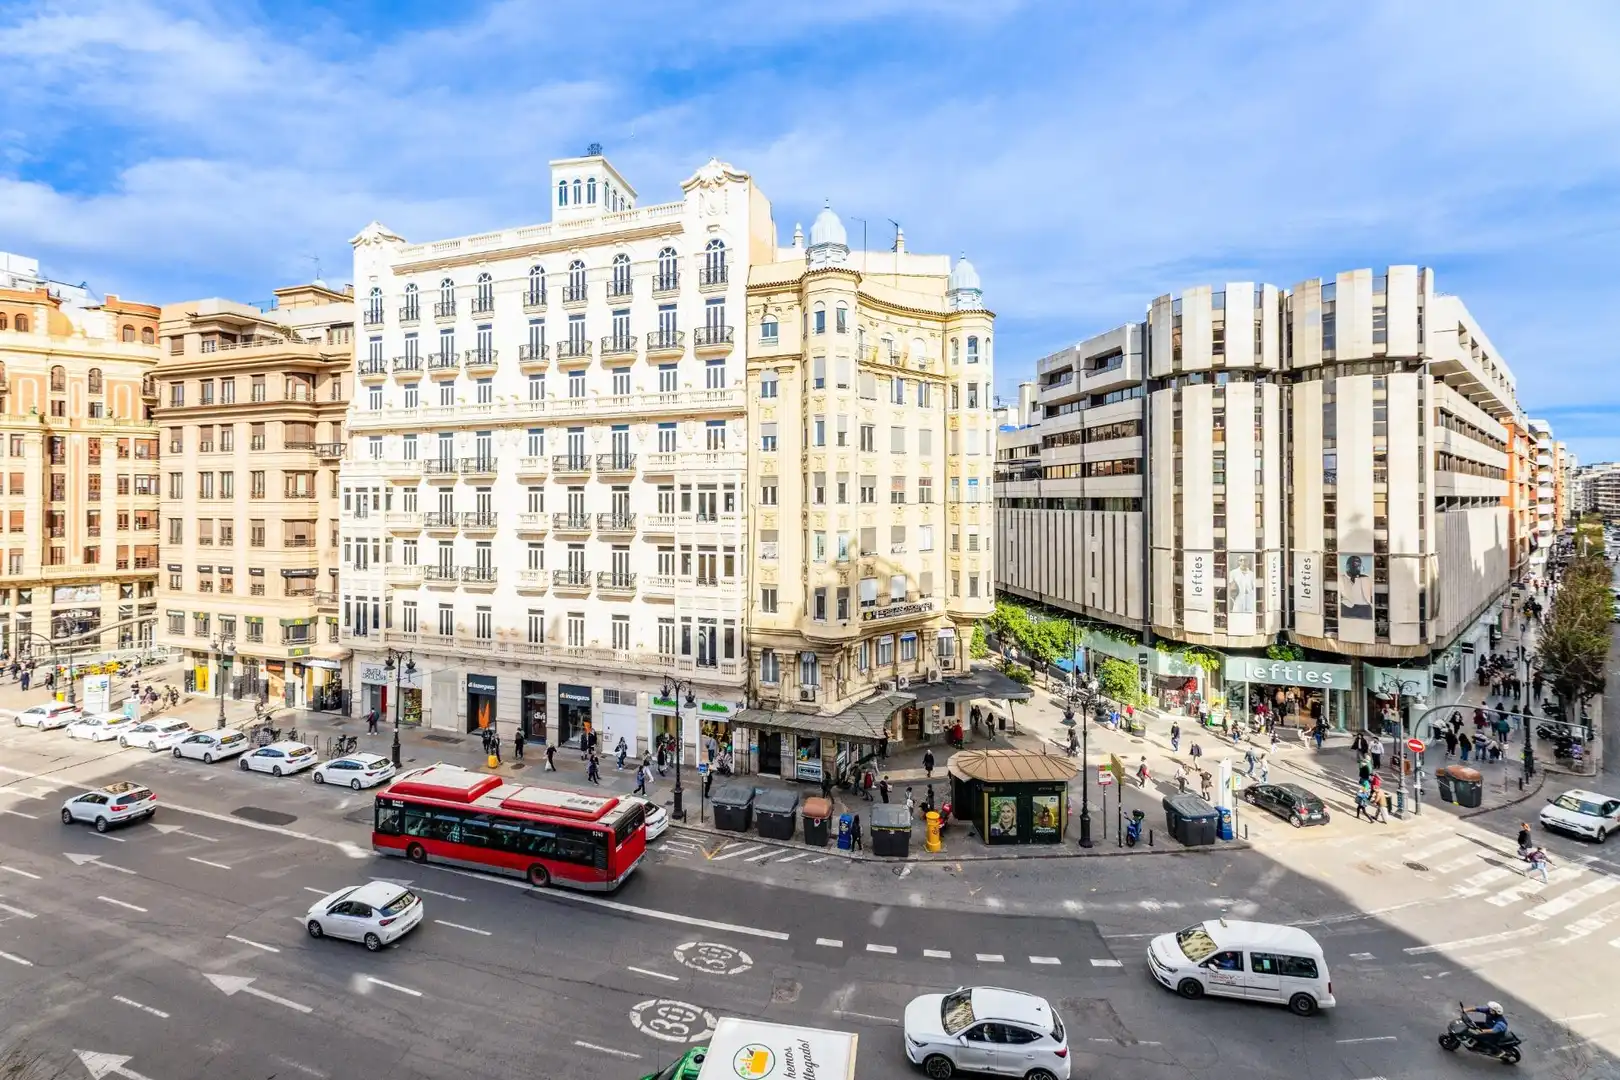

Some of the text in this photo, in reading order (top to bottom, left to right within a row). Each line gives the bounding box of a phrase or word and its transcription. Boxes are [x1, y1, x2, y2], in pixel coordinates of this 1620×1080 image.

[1192, 556, 1203, 597] lefties
[1301, 557, 1311, 600] lefties
[1245, 661, 1333, 684] lefties
[692, 947, 733, 970] 30
[650, 1007, 697, 1036] 30
[783, 1047, 797, 1079] hemos
